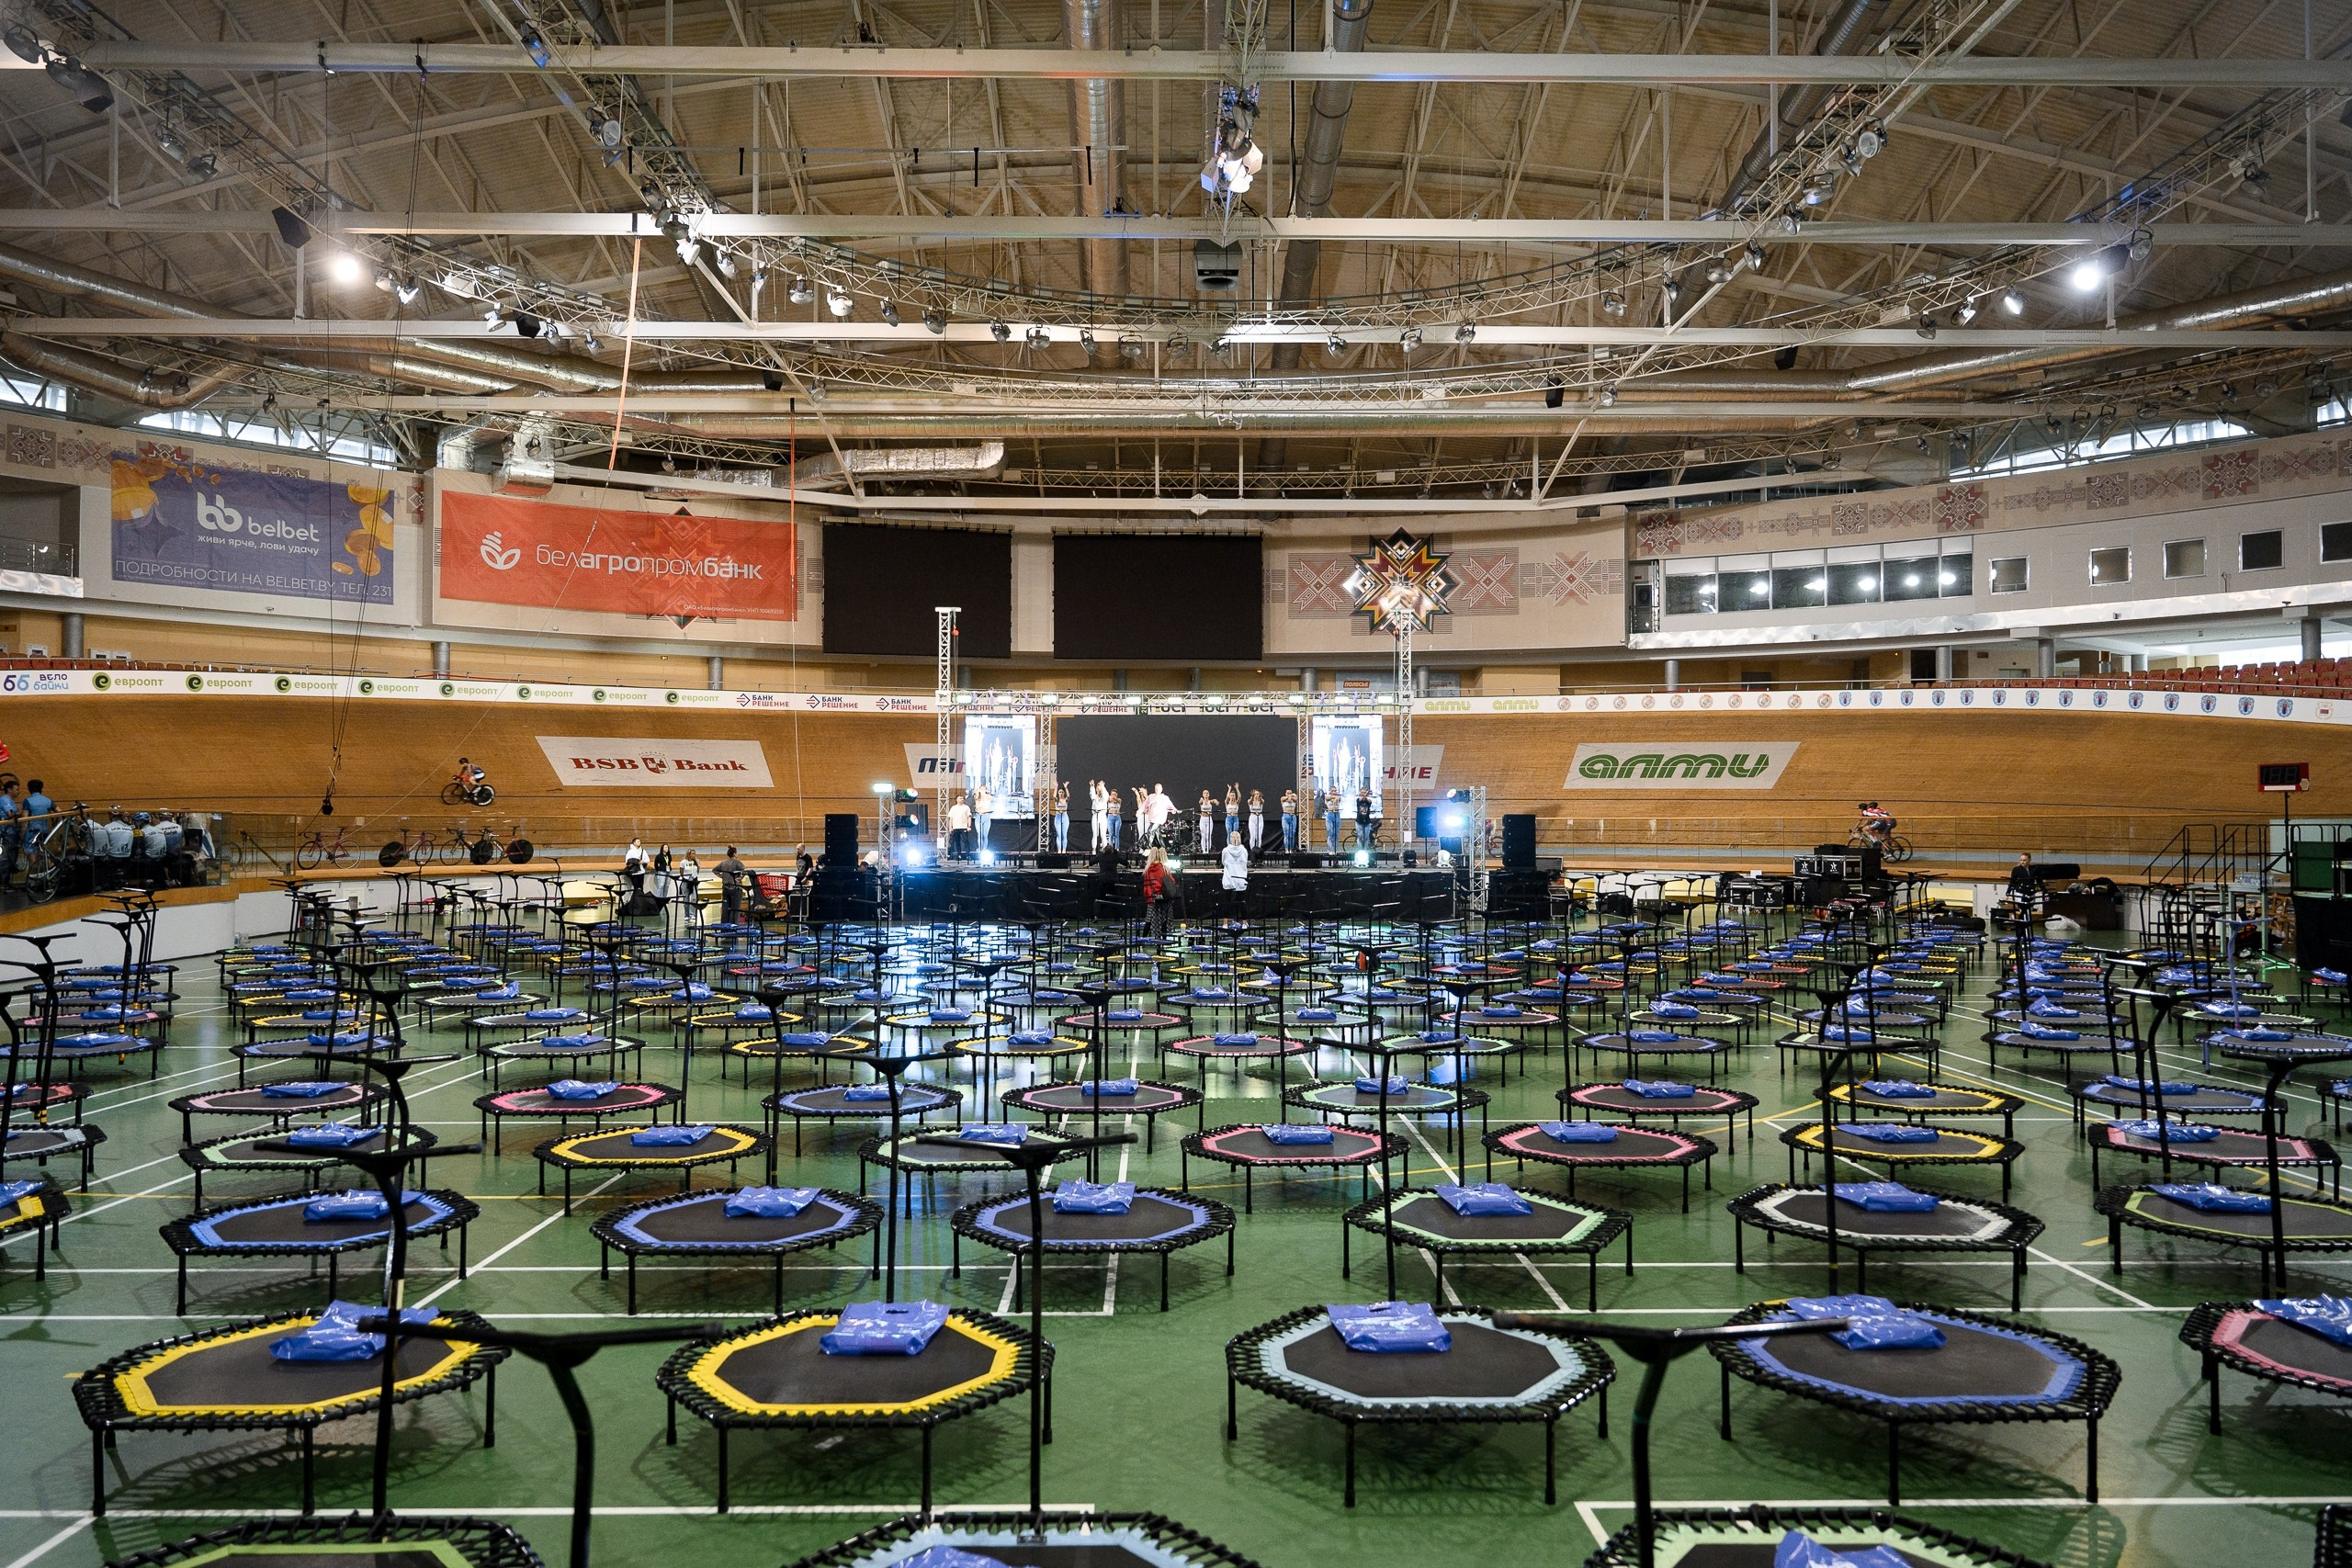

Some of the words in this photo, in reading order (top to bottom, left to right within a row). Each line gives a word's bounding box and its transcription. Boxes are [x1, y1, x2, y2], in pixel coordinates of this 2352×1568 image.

[248, 516, 320, 542] belbet
[198, 535, 225, 545] живи
[229, 538, 257, 548] ярче,
[260, 542, 286, 551] лови
[288, 545, 319, 556] удачу
[537, 544, 763, 580] белагропромбанк
[116, 560, 237, 583] ПОДРОБНОСТИ
[242, 573, 262, 585] НА
[372, 585, 392, 597] 231
[34, 682, 68, 691] байки
[115, 677, 164, 688] евроопт
[207, 679, 253, 689] евроопт
[294, 681, 338, 692] евроопт
[378, 684, 419, 694] евроопт
[458, 685, 498, 695] евроопт
[535, 689, 573, 699] евроопт
[682, 694, 718, 703] евроопт
[569, 758, 639, 770] BSB
[672, 760, 749, 771] Bank
